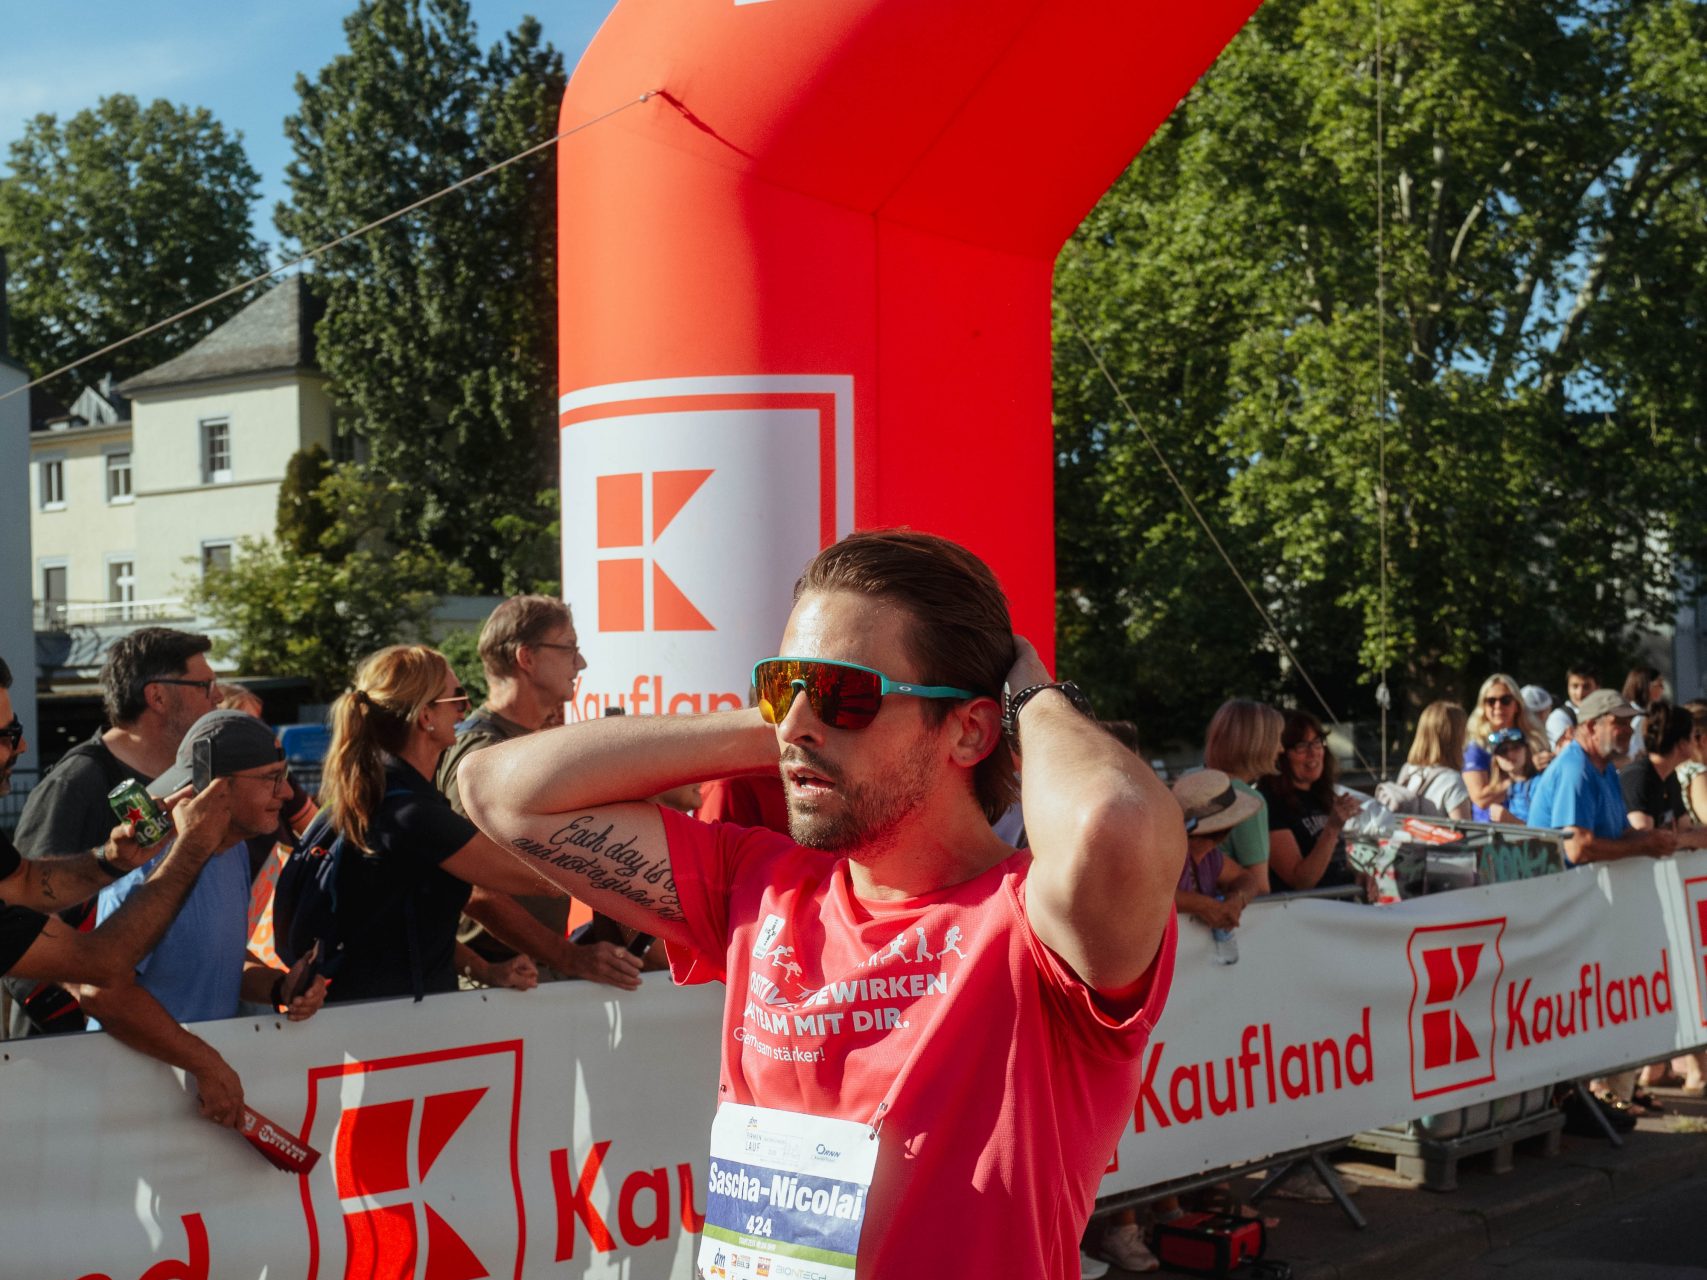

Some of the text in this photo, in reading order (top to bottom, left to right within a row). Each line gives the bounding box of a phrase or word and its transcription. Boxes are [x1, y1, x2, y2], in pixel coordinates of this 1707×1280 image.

[570, 674, 743, 722] Kauflan
[512, 838, 561, 861] and
[551, 852, 598, 874] not
[549, 816, 614, 853] Each
[604, 835, 649, 877] day
[1506, 949, 1673, 1051] Kaufland
[794, 1013, 844, 1036] MIT
[852, 1008, 910, 1033] DIR.
[774, 1047, 825, 1062] stärker!
[1135, 1006, 1374, 1133] Kaufland
[708, 1162, 863, 1221] Sascha-Nicolai
[746, 1215, 772, 1237] 424
[714, 1247, 726, 1268] dm
